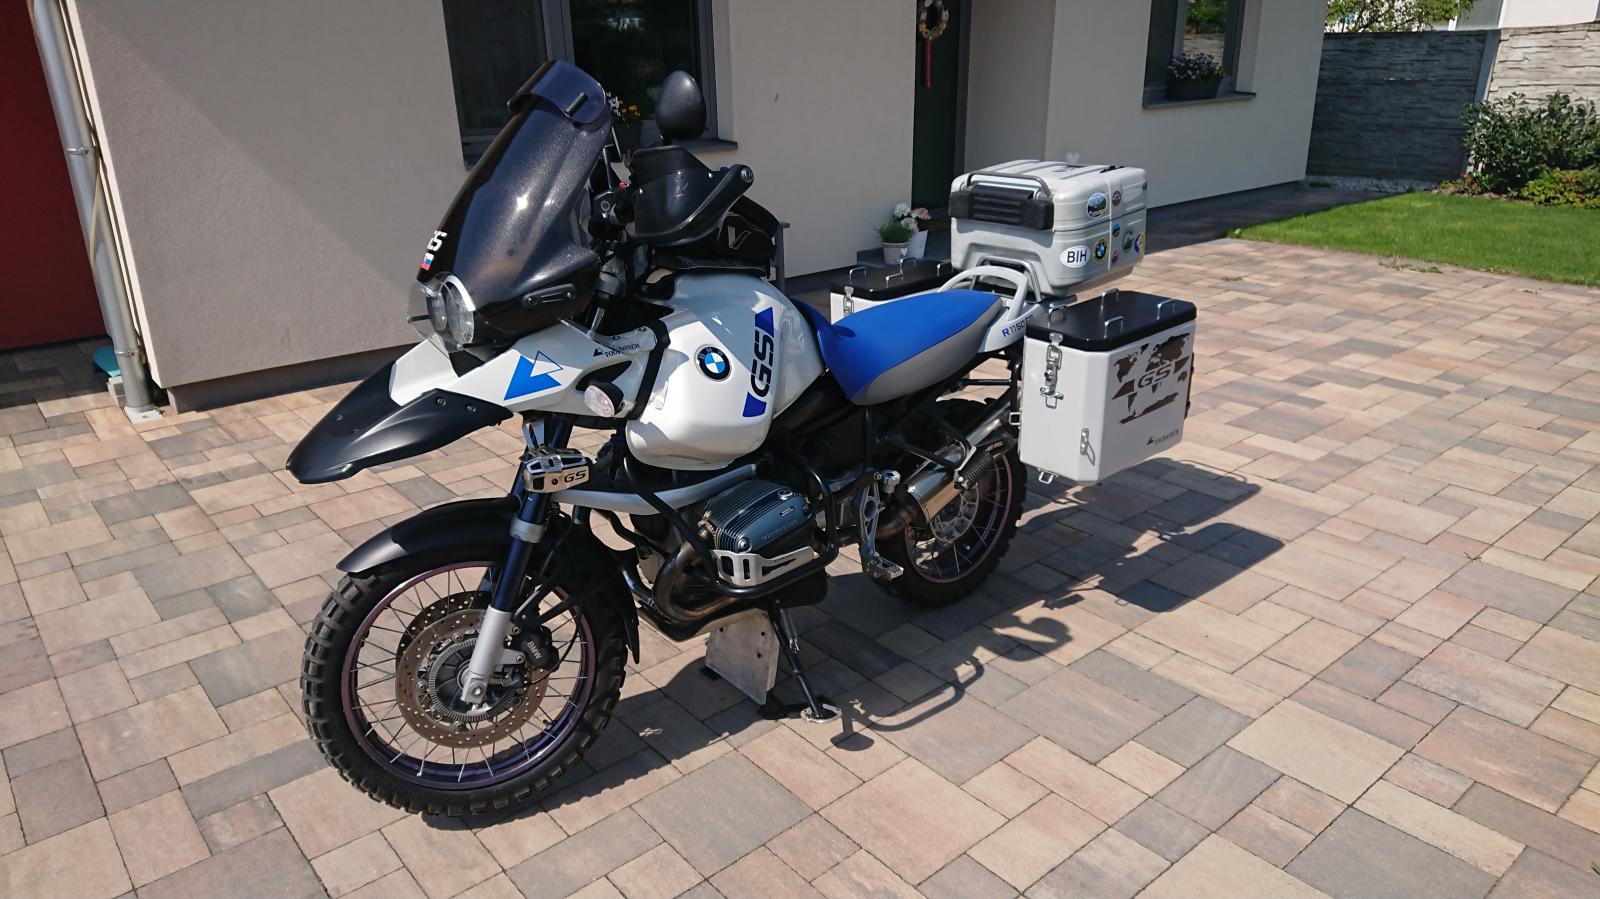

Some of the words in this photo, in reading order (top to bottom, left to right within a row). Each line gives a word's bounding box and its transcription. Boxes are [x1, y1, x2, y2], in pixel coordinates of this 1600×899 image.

[1067, 248, 1088, 264] BIH
[750, 329, 775, 398] GS
[1138, 362, 1173, 388] GS
[564, 469, 587, 483] GS
[526, 640, 543, 660] BMW
